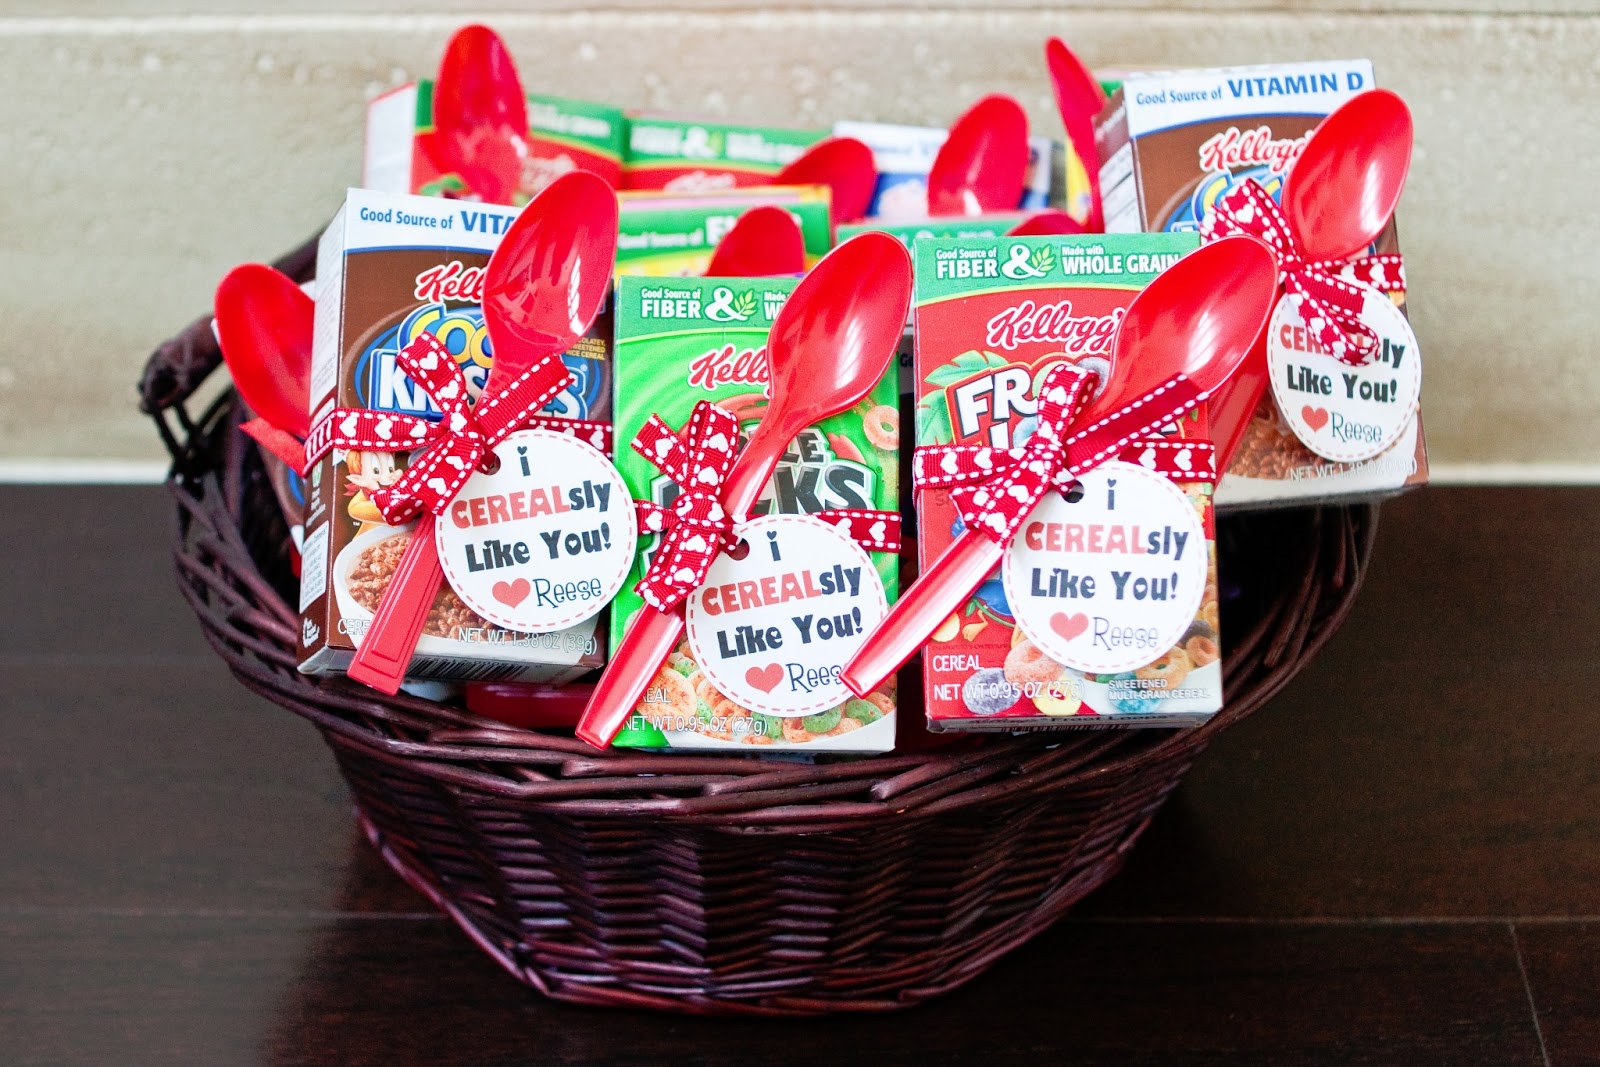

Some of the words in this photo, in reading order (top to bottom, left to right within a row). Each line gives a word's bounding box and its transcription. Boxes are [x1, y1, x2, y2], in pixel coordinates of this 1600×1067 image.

[1136, 88, 1166, 105] Good
[1170, 86, 1208, 103] Source
[1211, 87, 1222, 100] of
[1227, 73, 1338, 98] VITAMIN
[1346, 72, 1364, 91] D
[360, 207, 392, 223] Good
[396, 211, 437, 227] Source
[441, 216, 453, 229] of
[936, 249, 957, 260] Good
[959, 248, 986, 259] Source
[988, 247, 997, 258] of
[1001, 244, 1048, 279] &
[1061, 256, 1122, 274] WHOLE
[1062, 246, 1084, 256] Made
[1086, 245, 1104, 255] with
[936, 260, 999, 279] FIBER
[641, 288, 662, 299] Good
[664, 288, 691, 299] Source
[692, 288, 701, 300] of
[641, 299, 701, 318] FIBER
[704, 287, 748, 322] &
[1287, 364, 1332, 396] Like
[1342, 373, 1398, 403] You!
[1331, 412, 1382, 444] Reese
[517, 446, 531, 477] i
[1290, 464, 1312, 482] NET
[1315, 462, 1335, 479] WT
[451, 480, 611, 529] CEREALsly
[1107, 479, 1117, 510] i
[465, 539, 531, 573] Like
[540, 522, 612, 560] You!
[767, 530, 781, 562] i
[1025, 521, 1189, 561] CEREALsly
[533, 577, 602, 608] Reese
[702, 564, 861, 616] CEREALsly
[1031, 568, 1096, 599] Like
[1110, 571, 1178, 601] You!
[338, 618, 371, 636] CERE
[458, 627, 484, 644] NET
[487, 629, 508, 645] WT
[512, 631, 539, 648] 1.38
[542, 633, 560, 650] OZ
[563, 633, 598, 655] (39g)
[717, 626, 783, 659] Like
[791, 606, 863, 644] You!
[1092, 617, 1158, 650] Reese
[932, 654, 984, 672] CEREAL
[934, 683, 961, 700] NET
[964, 683, 987, 699] WT
[989, 682, 1021, 699] 0.95
[1024, 681, 1043, 698] OZ
[1046, 679, 1085, 701] (27g)
[1109, 679, 1168, 689] SWEETENED
[1109, 689, 1170, 700] MULTI-GRAIN
[623, 716, 648, 732] NET
[651, 716, 674, 732] WT
[676, 716, 707, 732] 0.95
[710, 717, 727, 732] OZ
[731, 716, 768, 736] (27g)
